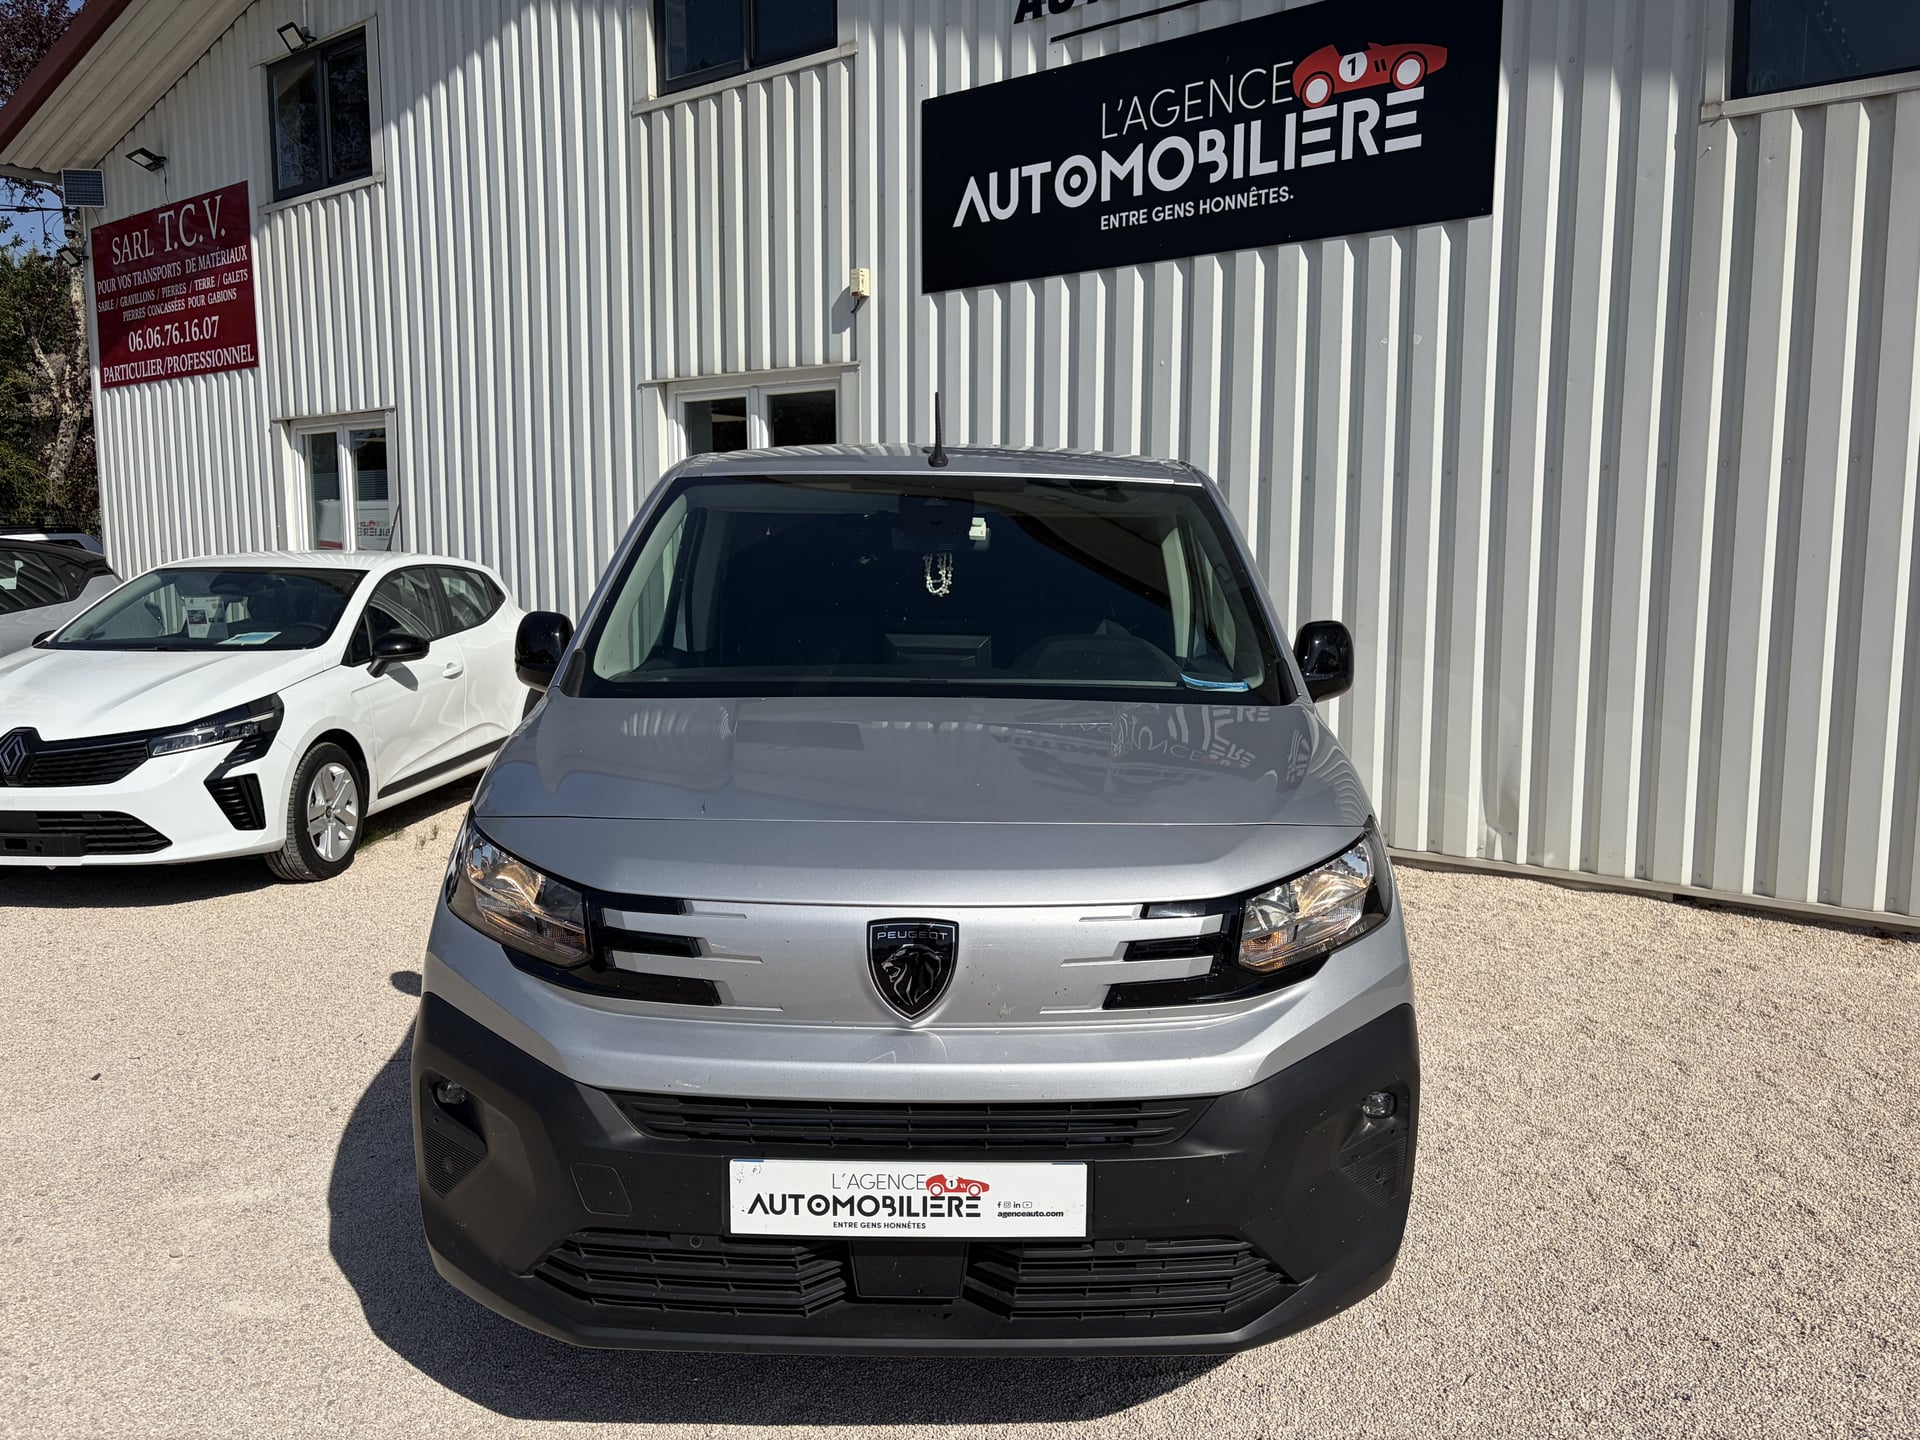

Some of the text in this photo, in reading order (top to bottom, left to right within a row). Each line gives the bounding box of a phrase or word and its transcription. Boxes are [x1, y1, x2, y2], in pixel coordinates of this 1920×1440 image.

[1100, 187, 1295, 230] ENTRE GENS HONNÊTES.
[112, 195, 226, 266] SARL T.C.V.
[97, 245, 248, 296] POUR VOS TRANSPORTS DE MATÉRIAUX
[97, 297, 115, 313] SABLE
[119, 290, 155, 307] GRAVILLONS
[161, 283, 187, 298] PIERRES
[194, 276, 216, 292] TERRE
[223, 269, 249, 286] GALETS
[122, 309, 146, 322] PIERRES
[188, 294, 205, 309] POUR
[207, 288, 237, 305] GABIONS
[128, 315, 220, 352] 06.06.76.16.07
[103, 344, 255, 383] PARTICULIER/PROFESSIONNEL
[877, 930, 949, 940] PEUGEOT
[883, 1220, 926, 1230] HONNÊTES
[997, 1210, 1064, 1218] agenceauto.com
